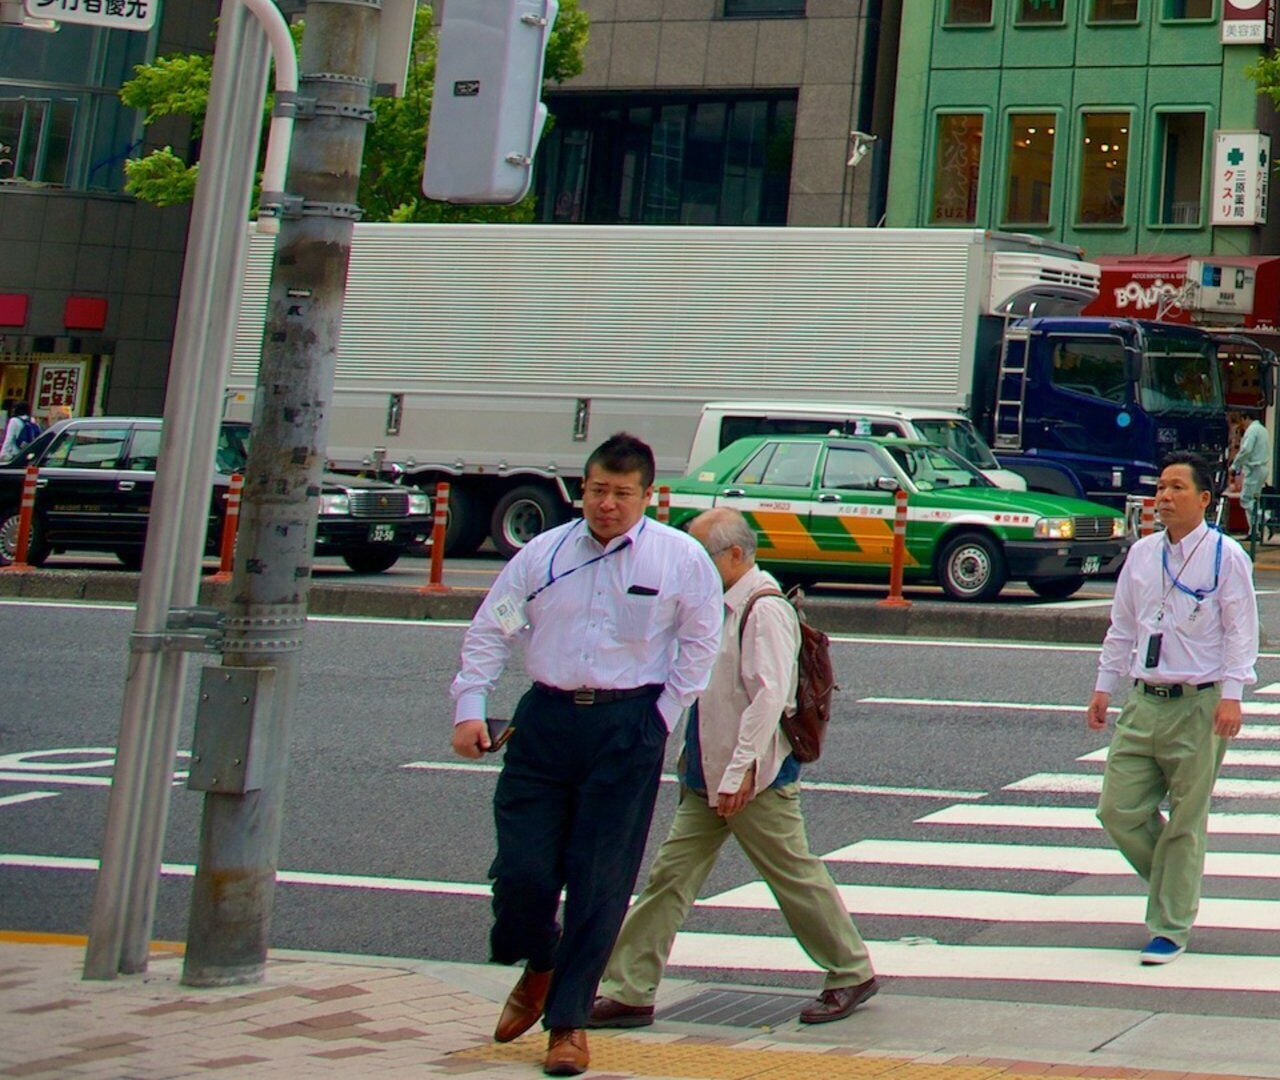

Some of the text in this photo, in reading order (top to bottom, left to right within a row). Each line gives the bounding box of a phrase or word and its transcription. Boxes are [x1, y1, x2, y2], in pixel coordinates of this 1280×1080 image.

[1222, 170, 1234, 217] クスリ
[1233, 170, 1247, 217] 三原薬局
